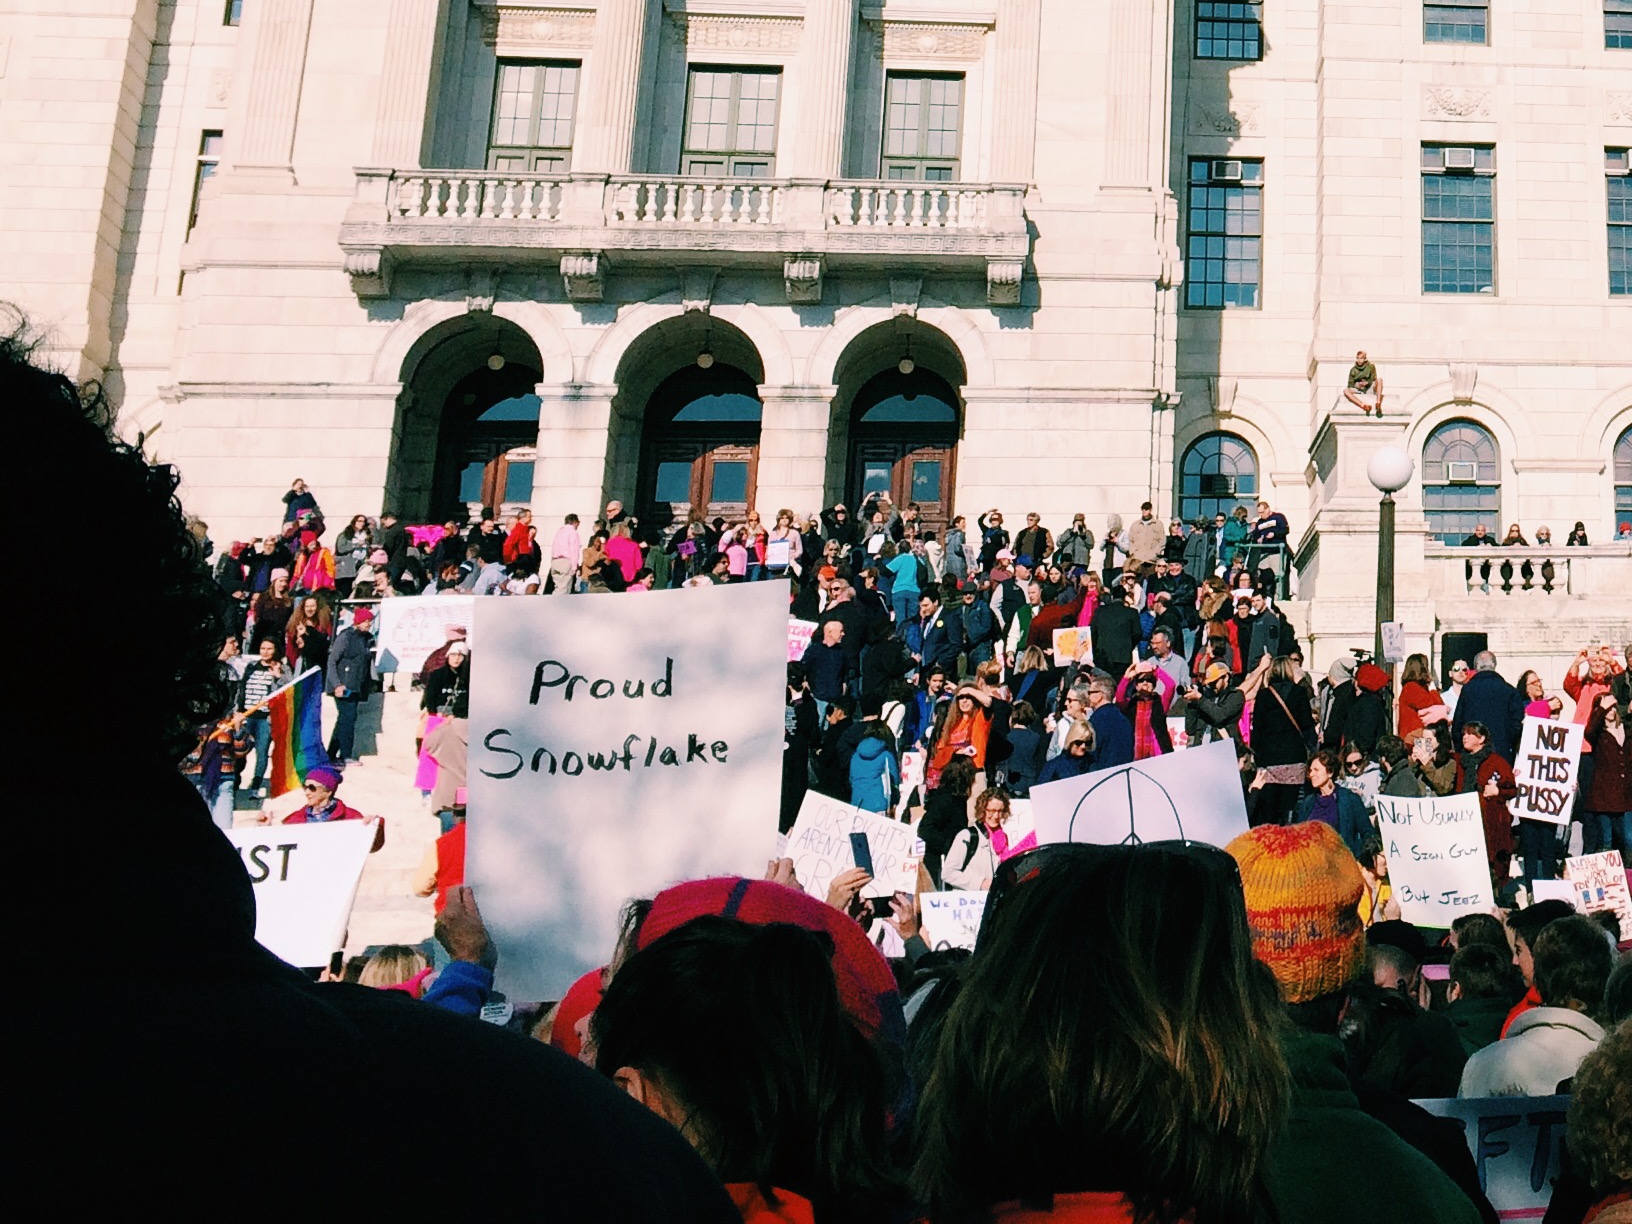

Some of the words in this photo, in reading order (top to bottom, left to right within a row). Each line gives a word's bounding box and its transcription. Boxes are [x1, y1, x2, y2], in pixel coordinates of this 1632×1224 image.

[529, 656, 674, 705] Proud
[479, 728, 729, 779] Snowflake
[1535, 724, 1569, 753] NOT
[1527, 753, 1571, 783] THIS
[1514, 782, 1570, 817] PUSSY
[1390, 840, 1401, 858] A
[1602, 852, 1621, 867] YOU
